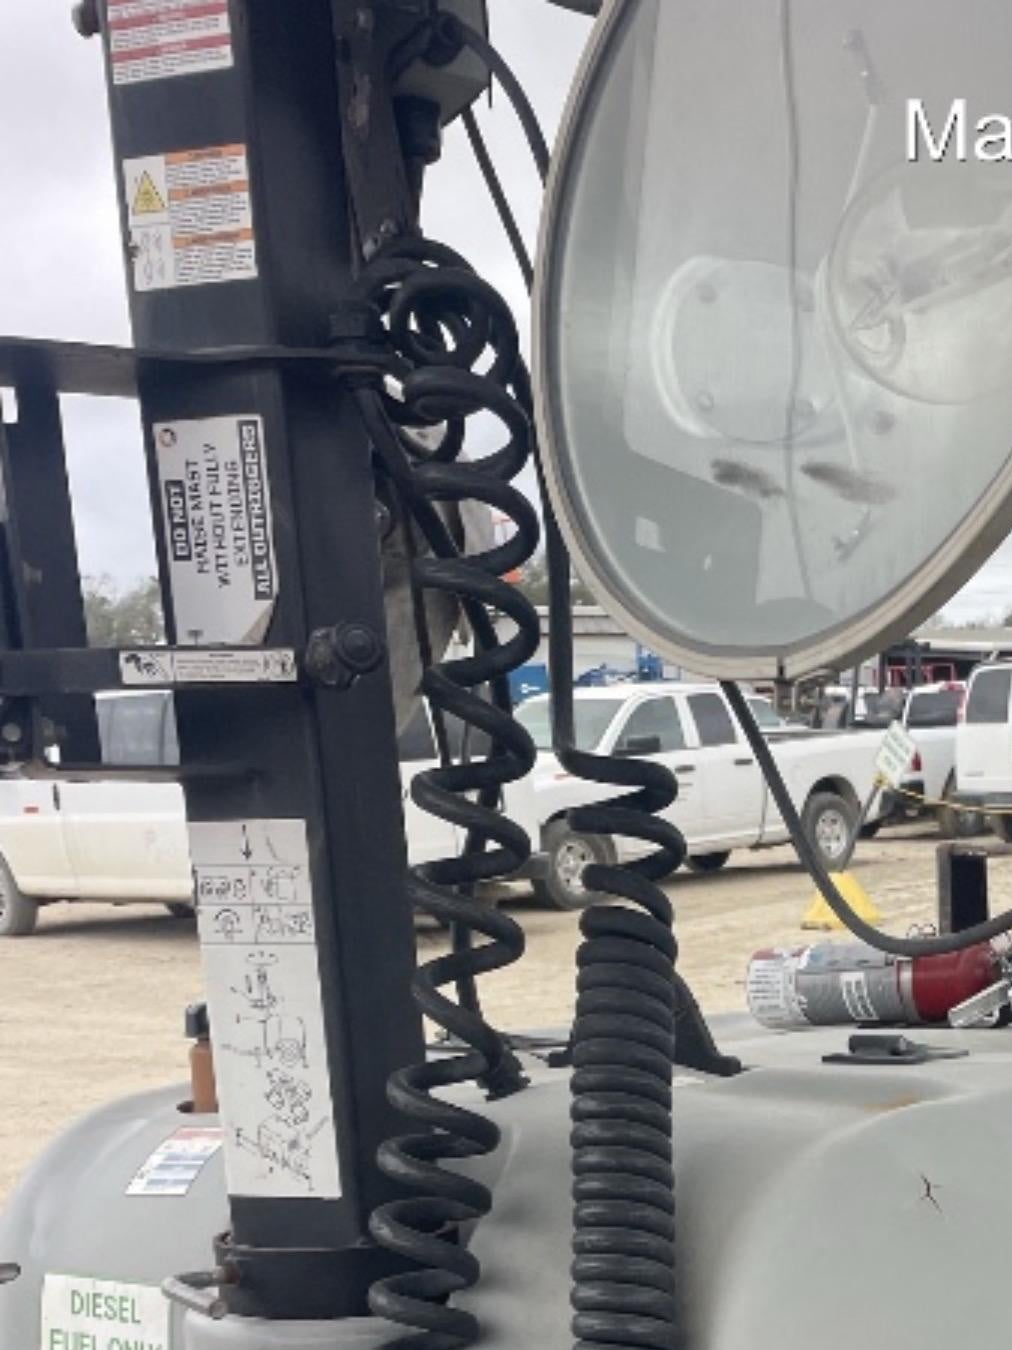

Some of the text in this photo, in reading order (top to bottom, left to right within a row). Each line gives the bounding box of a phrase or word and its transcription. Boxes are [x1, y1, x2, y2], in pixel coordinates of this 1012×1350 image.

[169, 484, 190, 557] DO NOT
[185, 458, 210, 574] RAISE MAST
[203, 443, 231, 589] WITHOUT FULLY
[225, 460, 250, 567] EXTENDING
[253, 558, 271, 595] ALL
[70, 1289, 142, 1324] DIESEL
